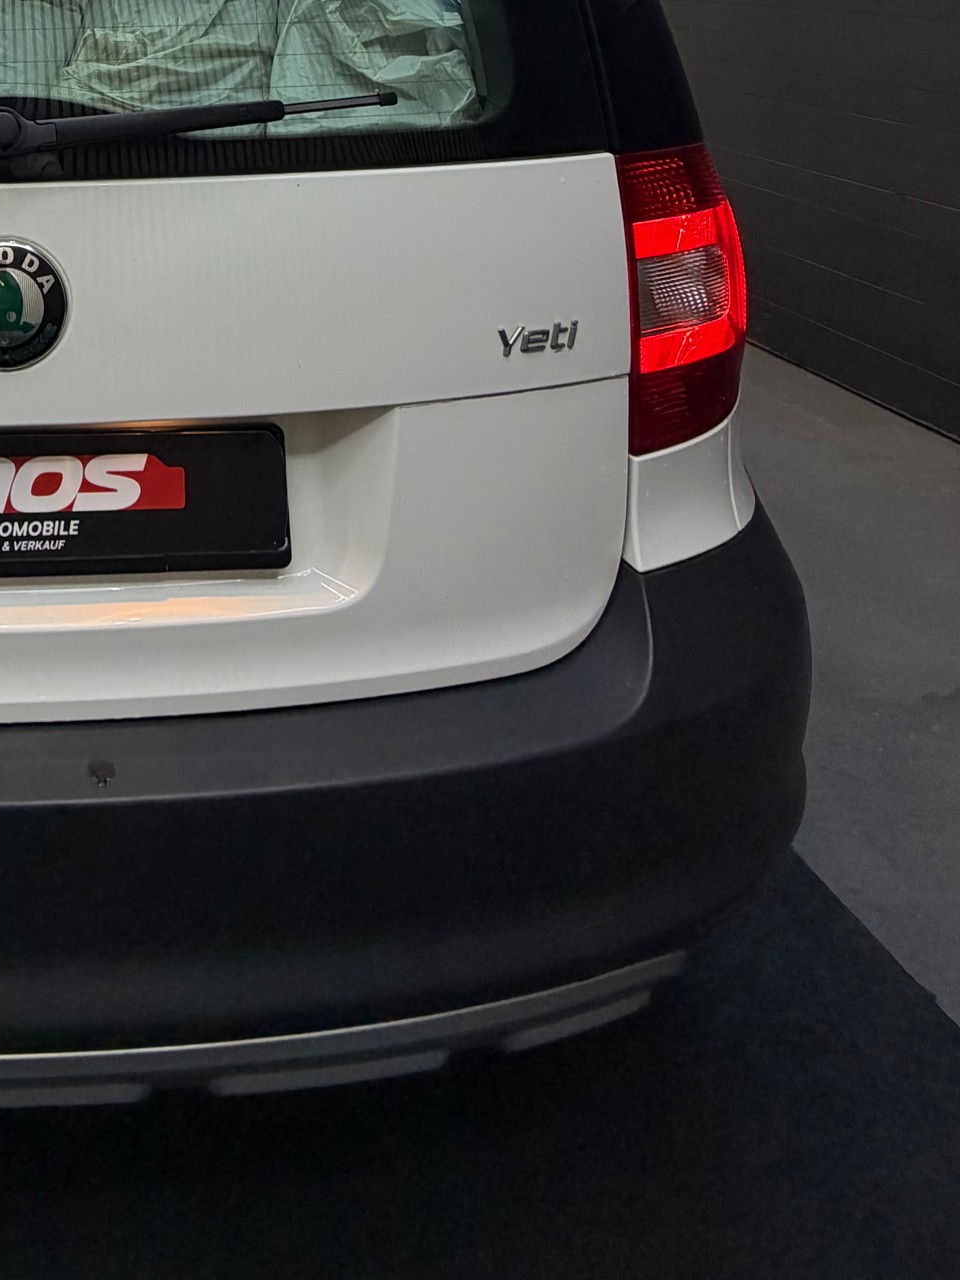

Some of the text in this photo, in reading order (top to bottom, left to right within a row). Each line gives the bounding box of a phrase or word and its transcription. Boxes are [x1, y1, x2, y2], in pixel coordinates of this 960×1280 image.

[497, 319, 579, 358] Yeti
[1, 541, 11, 552] &
[14, 539, 66, 552] VERKAUF
